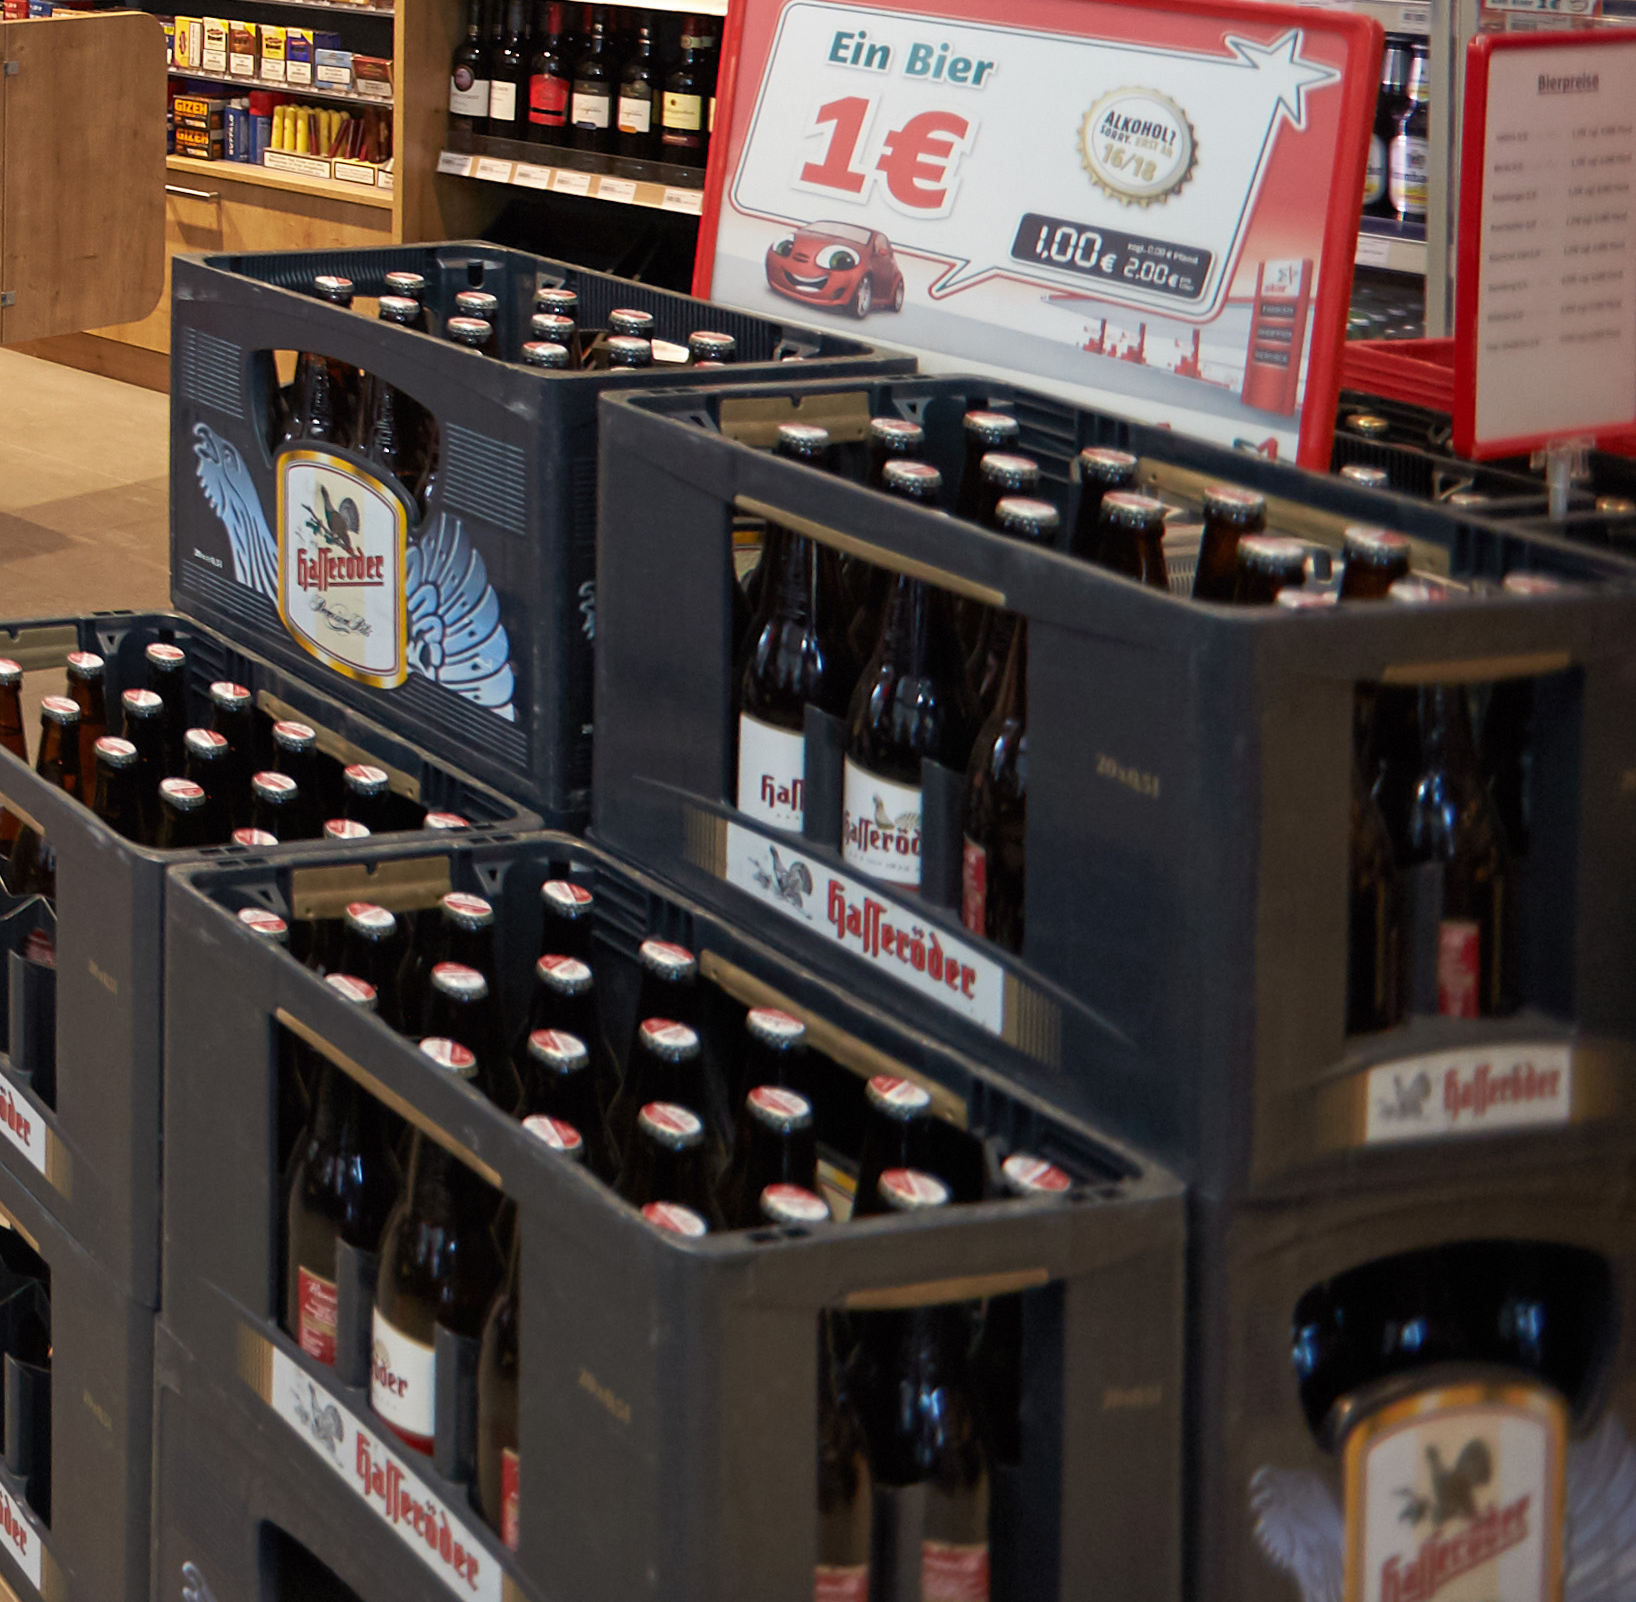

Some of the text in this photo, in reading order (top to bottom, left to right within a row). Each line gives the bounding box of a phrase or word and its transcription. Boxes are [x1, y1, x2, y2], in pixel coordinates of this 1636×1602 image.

[827, 30, 994, 90] Ein Bier
[1537, 72, 1600, 93] Bierpreise
[174, 98, 208, 116] GIZEH
[1104, 109, 1177, 145] ALKOHOL?
[1103, 141, 1158, 183] 16/18
